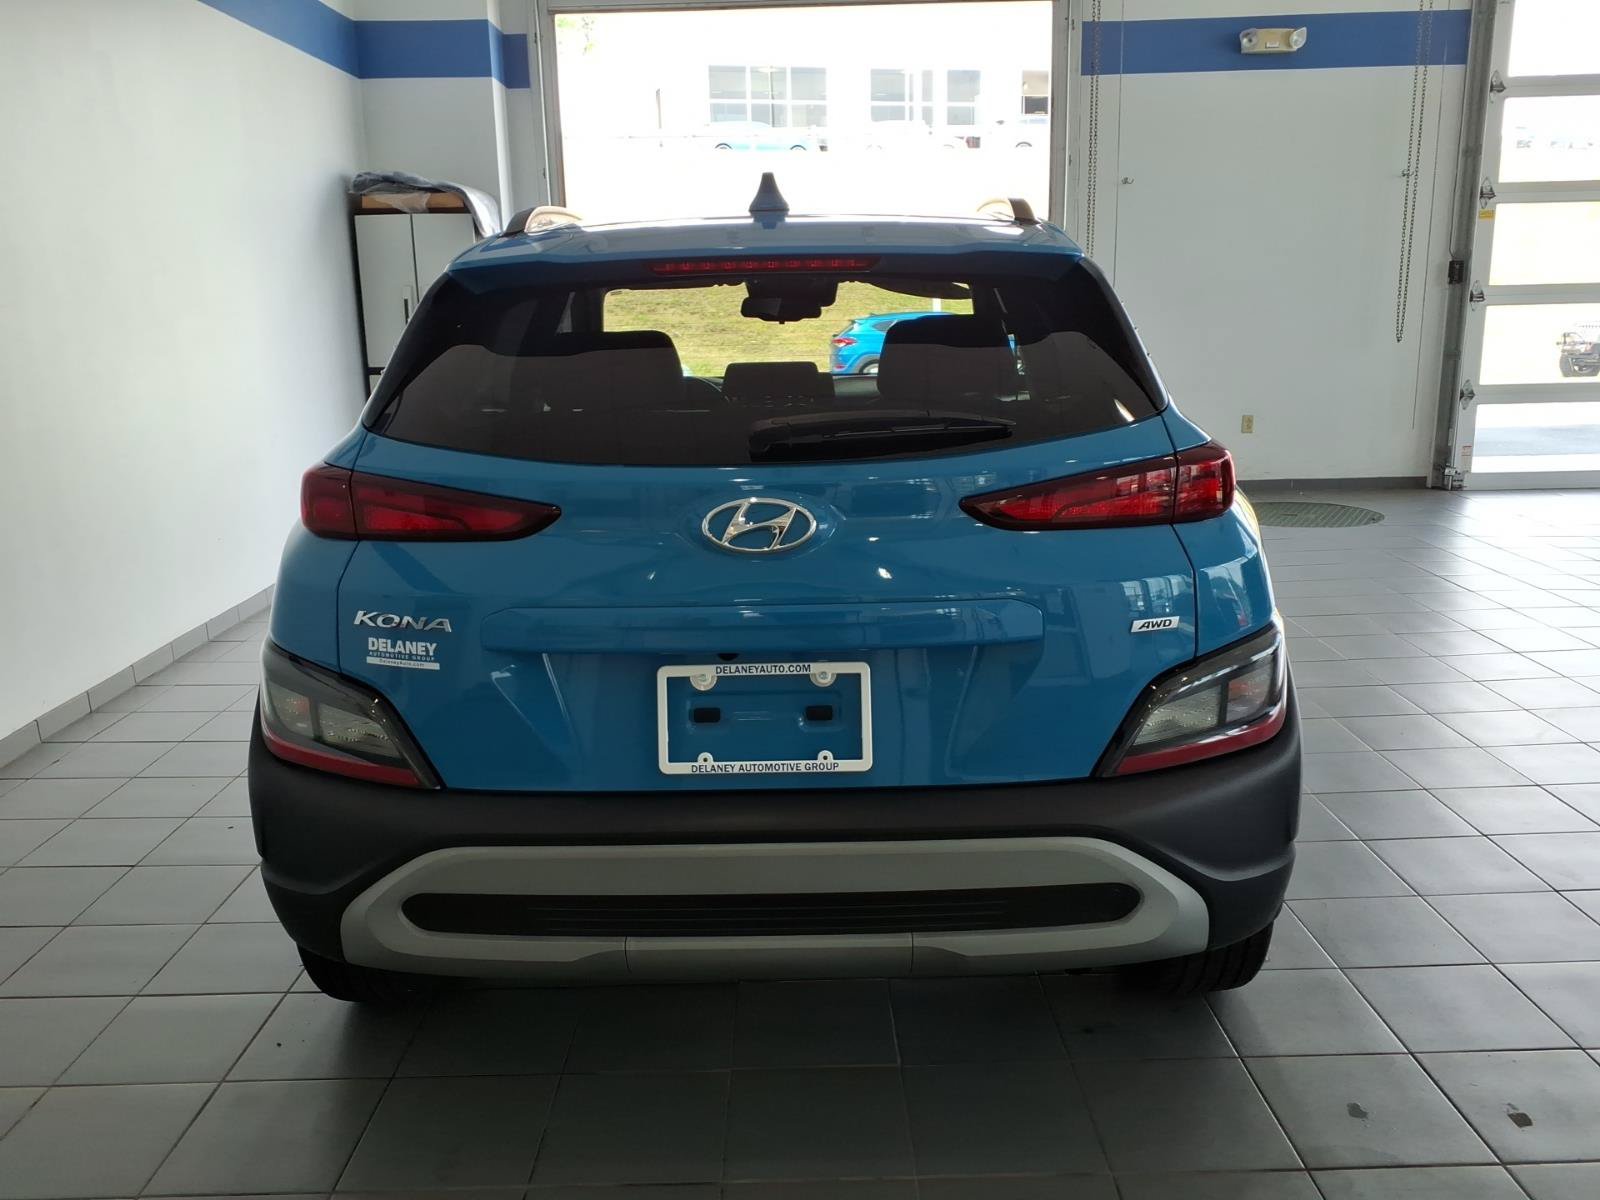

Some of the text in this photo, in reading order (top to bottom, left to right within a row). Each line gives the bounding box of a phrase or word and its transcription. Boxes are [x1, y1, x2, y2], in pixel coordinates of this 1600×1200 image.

[353, 610, 452, 633] KONA
[1138, 618, 1173, 630] AWD
[368, 637, 437, 656] DELANEY
[369, 651, 409, 660] AUTOMOTIVE
[715, 664, 811, 675] DELANEYAUTO.COM
[691, 762, 840, 773] DELANEY AUTOMOTIVE GROUP
